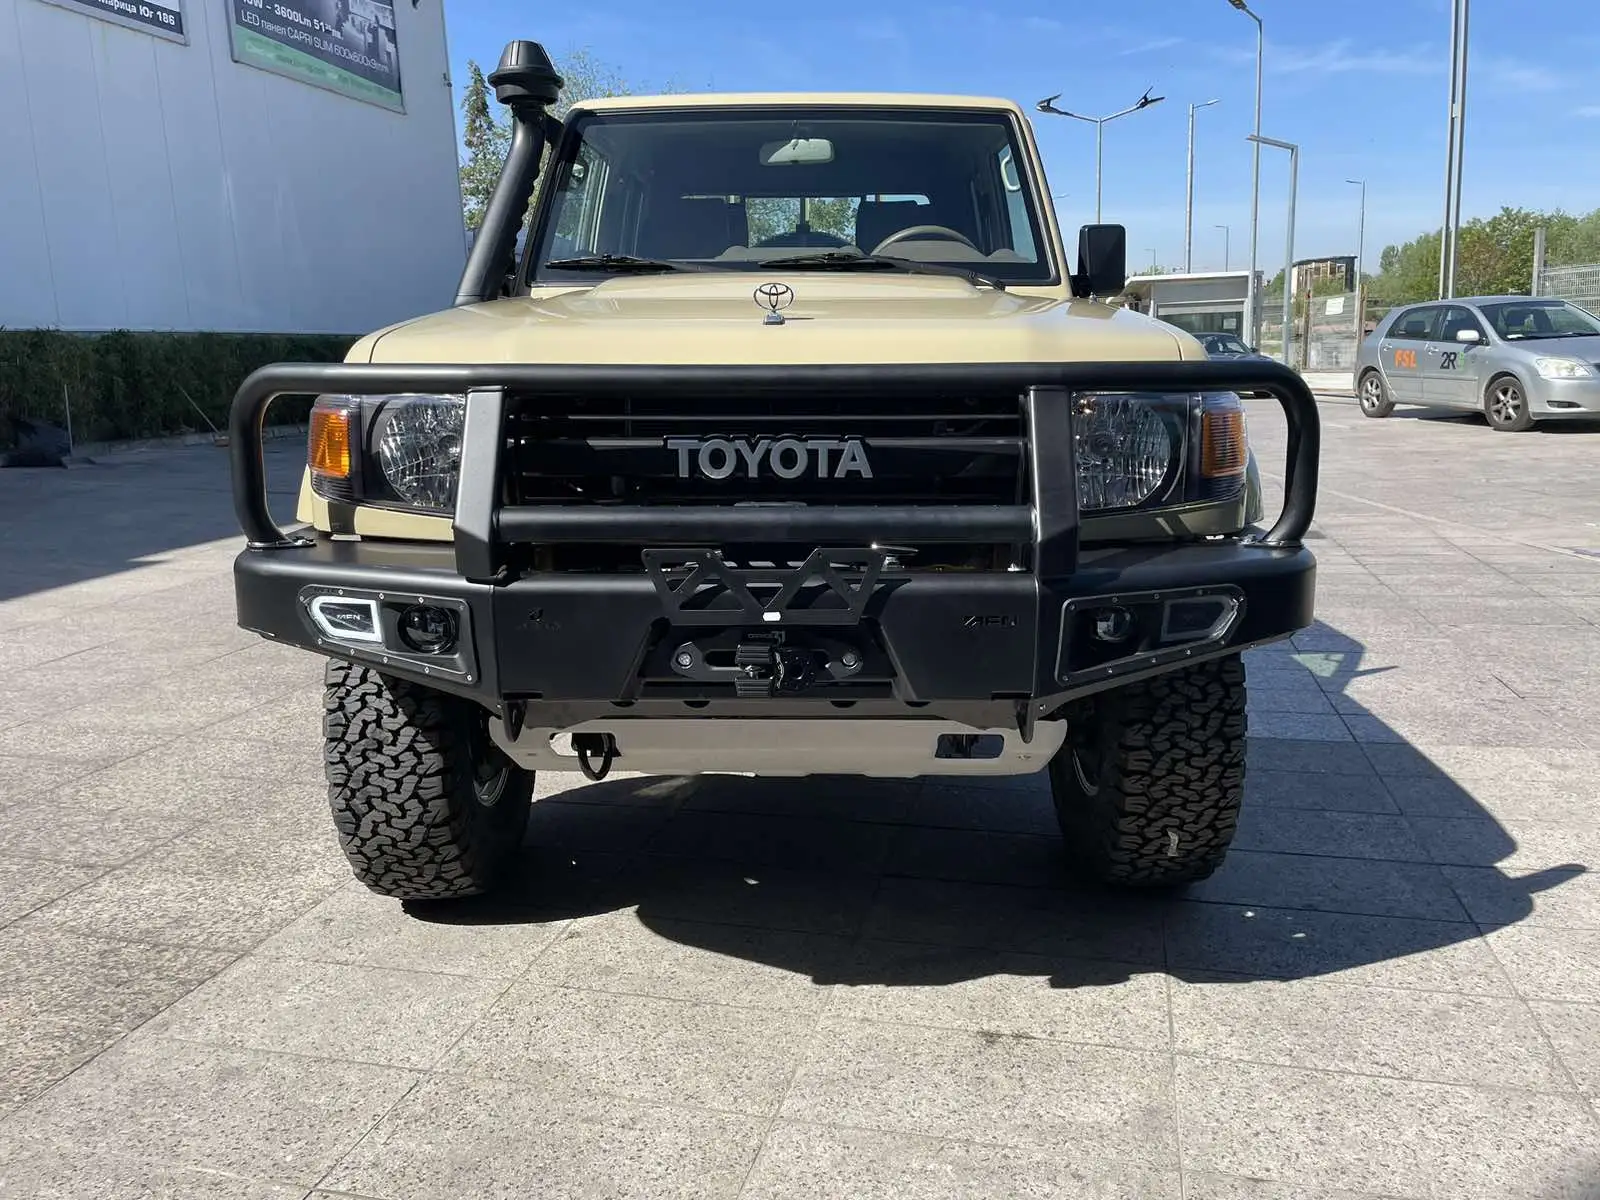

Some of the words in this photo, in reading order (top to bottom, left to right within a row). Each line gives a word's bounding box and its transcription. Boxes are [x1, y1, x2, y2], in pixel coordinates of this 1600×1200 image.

[139, 5, 154, 19] Юг
[156, 11, 176, 26] 186
[241, 9, 259, 26] LED
[261, 19, 287, 35] панел
[287, 26, 313, 45] CAPRI
[313, 36, 333, 53] SLIM
[666, 437, 874, 480] TOYOTA
